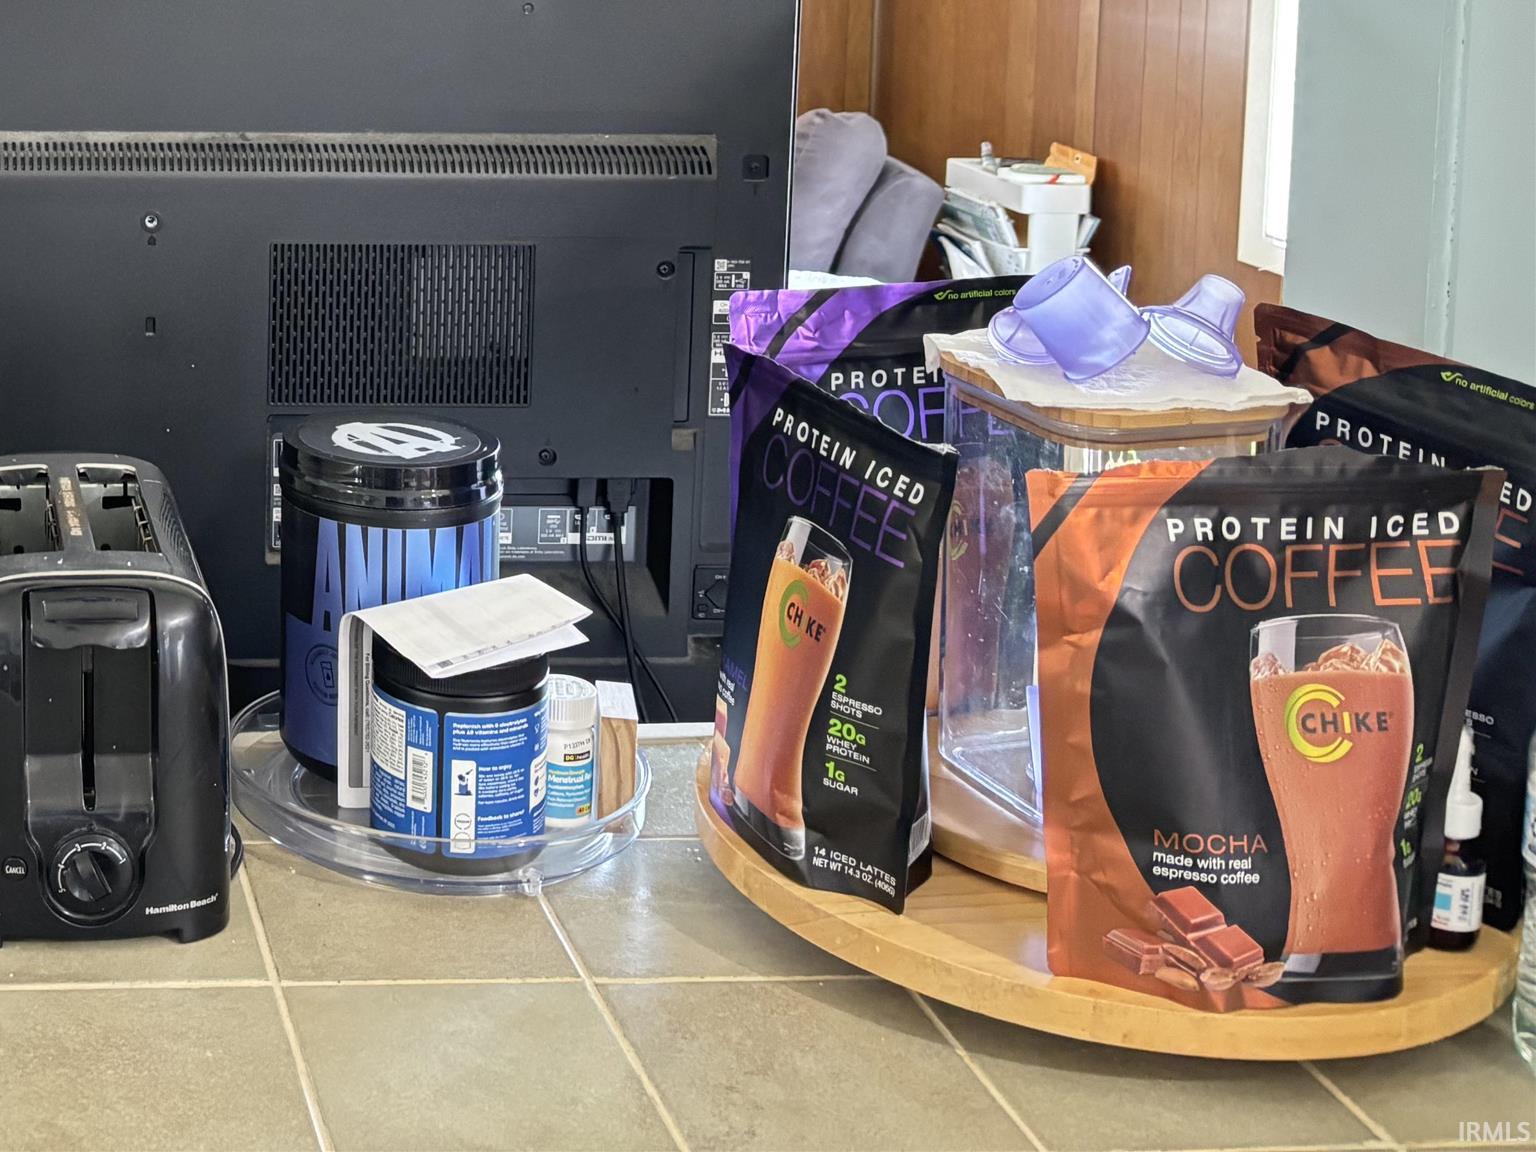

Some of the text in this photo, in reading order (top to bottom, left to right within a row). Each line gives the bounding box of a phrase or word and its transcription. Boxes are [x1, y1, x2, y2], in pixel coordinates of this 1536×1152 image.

[960, 289, 993, 299] artificial
[994, 288, 1016, 297] colors
[830, 366, 942, 391] PROTEI
[1455, 377, 1468, 388] no
[1469, 382, 1509, 401] artificial
[771, 407, 925, 505] PROTEIN ICED
[763, 433, 916, 569] COFFEE
[1166, 511, 1462, 543] PROTEIN ICED
[1173, 538, 1463, 614] COFFEE
[833, 673, 848, 693] 2
[830, 700, 863, 719] SHOTS
[831, 691, 883, 716] ESPRESSO
[827, 718, 866, 746] 20G
[1299, 710, 1391, 734] CHIKE
[825, 743, 871, 765] PROTEIN
[826, 734, 857, 751] WHEY
[547, 773, 584, 785] Menstrual
[825, 761, 846, 783] 1G
[822, 777, 859, 797] SUGAR
[1152, 828, 1269, 856] MOCHA
[5, 864, 26, 875] CANCEL
[812, 856, 829, 869] NET
[829, 860, 843, 872] WT
[844, 866, 861, 879] 14.3
[861, 873, 874, 885] OZ.
[814, 845, 897, 886] 14 ICED LATTES
[1152, 851, 1252, 870] made with real
[1152, 865, 1261, 884] espresso coffee
[145, 893, 217, 915] Hamilton Beach
